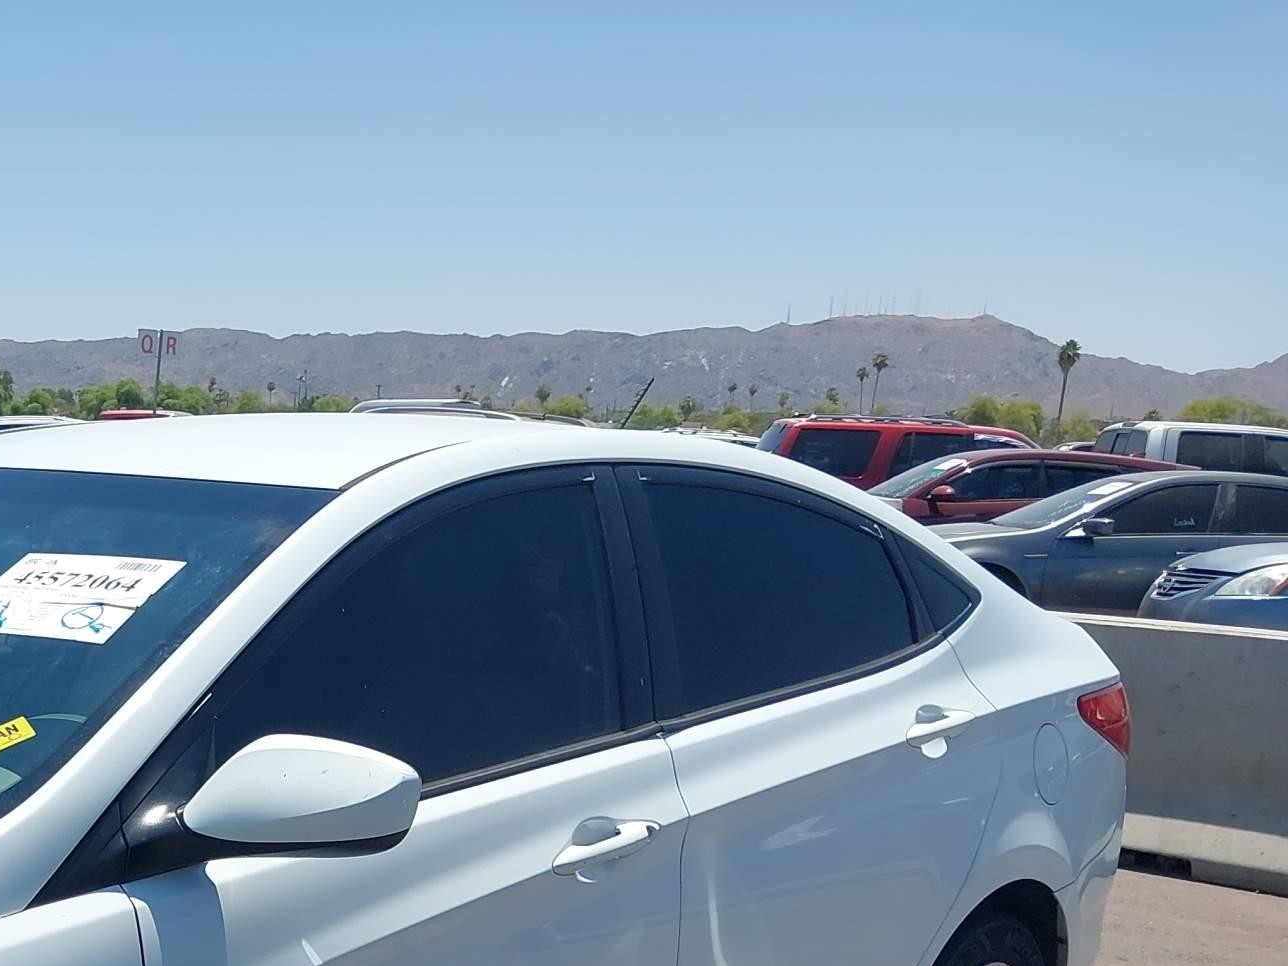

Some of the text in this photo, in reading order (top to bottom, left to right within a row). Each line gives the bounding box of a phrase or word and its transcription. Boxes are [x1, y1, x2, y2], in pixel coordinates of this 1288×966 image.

[141, 335, 153, 354] Q
[166, 336, 177, 355] R
[14, 570, 143, 592] 45572064
